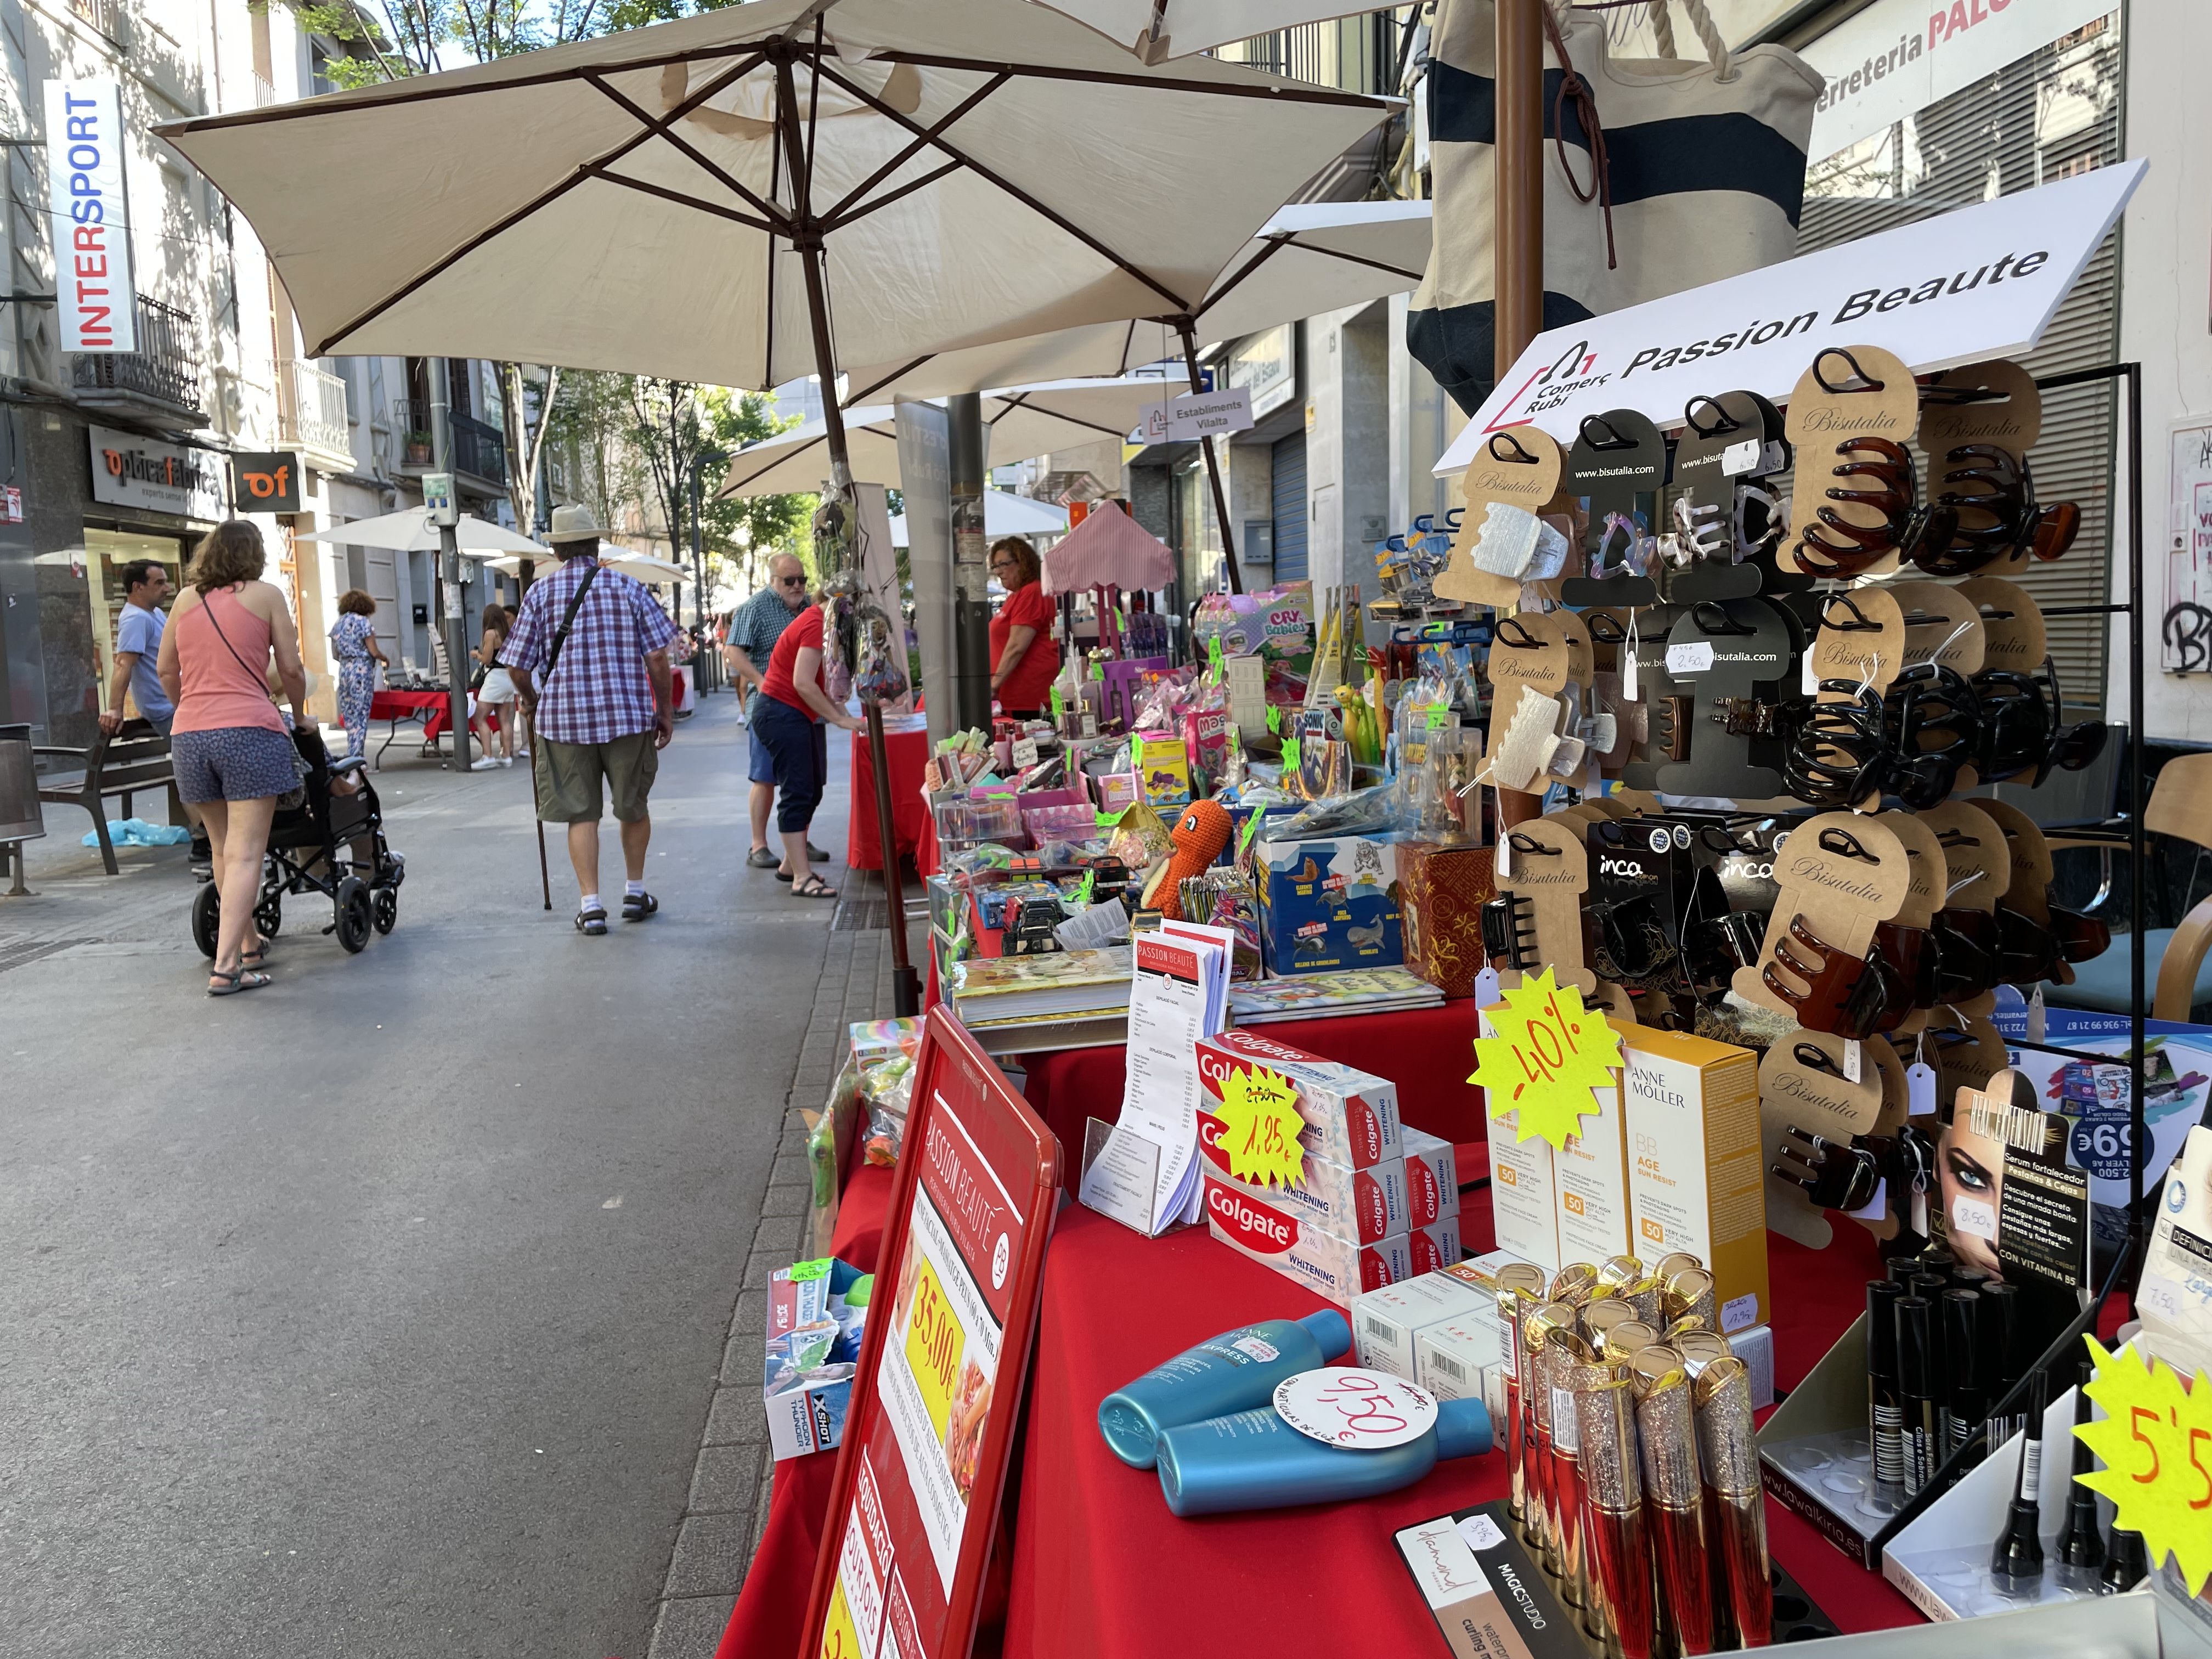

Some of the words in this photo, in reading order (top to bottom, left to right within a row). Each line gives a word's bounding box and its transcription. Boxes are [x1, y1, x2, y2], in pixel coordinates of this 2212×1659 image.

[1816, 33, 1921, 113] erreteria
[65, 91, 113, 347] INTERSPORT
[1622, 311, 1818, 380] Passion
[1830, 249, 2050, 325] Beaute
[1537, 371, 1612, 399] Comerç
[1176, 400, 1242, 419] Establiments
[1525, 392, 1575, 416] Rubí
[1196, 417, 1228, 429] Vilalta
[1803, 407, 1898, 431] Bisutalia
[1933, 415, 2023, 439] Bisutalia
[1575, 464, 1655, 479] www.bisutalia.com
[1681, 451, 1725, 469] www.bisuta
[1475, 471, 1543, 495] Bisutalia
[1265, 622, 1307, 636] Babies
[1269, 609, 1300, 625] CRY
[1714, 652, 1776, 661] isutalia.com
[1824, 640, 1888, 669] Bisutalia
[1903, 645, 1963, 661] sutalia
[1985, 636, 2027, 656] utalia
[1498, 658, 1556, 681] Bisutalia
[1304, 713, 1325, 729] SONIC
[1508, 866, 1577, 884] Bisutalia
[1600, 855, 1643, 877] inca
[1791, 856, 1884, 904] Bisutalia
[1138, 945, 1168, 962] PASSION
[1169, 952, 1195, 968] BEAUTÉ
[2011, 1023, 2027, 1032] 722
[2067, 1022, 2076, 1030] 87
[2080, 1021, 2090, 1030] 21
[2091, 1021, 2102, 1030] 99
[2103, 1020, 2119, 1030] 936
[1223, 1031, 1304, 1062] Colgate
[1511, 991, 1581, 1101] -40%
[1288, 1062, 1336, 1081] WHITENING
[1632, 1066, 1666, 1088] ANNE
[1632, 1080, 1685, 1109] MÖLLER
[1771, 1072, 1859, 1120] Bisutalia
[1365, 1110, 1378, 1159] Colgate
[1379, 1098, 1390, 1146] WHITENING
[1493, 1118, 1505, 1127] SUN
[1573, 1149, 1595, 1162] RESIST
[1635, 1132, 1658, 1156] BB
[1517, 1171, 1530, 1180] VERY
[1530, 1175, 1541, 1184] HIGH
[1637, 1156, 1660, 1173] AGE
[1637, 1168, 1652, 1180] SUN
[1652, 1173, 1678, 1188] RESIST
[2005, 1153, 2030, 1169] Serum
[2032, 1161, 2085, 1186] fortalecedor
[2098, 1168, 2129, 1177] 2.500
[927, 1115, 961, 1194] PASSION
[956, 1168, 1005, 1252] BEAUTÉ
[1424, 1171, 1435, 1218] Colgate
[1437, 1159, 1447, 1205] WHITENING
[2008, 1165, 2044, 1184] Pestañas
[2045, 1178, 2052, 1187] &
[2053, 1181, 2078, 1196] Cejas
[1283, 1185, 1329, 1211] WHITENING
[1372, 1186, 1383, 1235] Colgate
[1386, 1174, 1396, 1221] WHITENING
[1584, 1200, 1598, 1209] VERY
[1599, 1205, 1611, 1214] HIGH
[2003, 1193, 2012, 1201] de
[2013, 1197, 2026, 1206] una
[2027, 1201, 2051, 1215] mirada
[2052, 1209, 2076, 1223] bonita
[2004, 1183, 2035, 1200] Descubre
[2037, 1193, 2043, 1202] el
[2043, 1197, 2070, 1212] secreto
[1209, 1187, 1288, 1245] Colgate
[2002, 1204, 2033, 1222] Consigue
[2034, 1217, 2051, 1227] unas
[2002, 1214, 2032, 1231] pestañas
[2033, 1224, 2047, 1234] más
[2048, 1229, 2073, 1244] largas,
[1664, 1227, 1679, 1237] VERY
[1679, 1233, 1694, 1243] HIGH
[2001, 1221, 2028, 1236] espesas
[2028, 1231, 2033, 1239] y
[960, 1233, 975, 1263] VILALTA
[1427, 1243, 1440, 1272] gate
[1289, 1253, 1335, 1285] WHITENING
[1296, 1266, 1312, 1279] naturally
[1313, 1275, 1325, 1285] whiter
[1325, 1281, 1335, 1291] teeth
[1378, 1261, 1388, 1289] gate
[1999, 1249, 2018, 1263] CON
[2021, 1256, 2062, 1282] VITAMINA
[2064, 1276, 2076, 1286] B5
[914, 1275, 956, 1401] 35,00€
[982, 1324, 998, 1367] Min.)
[1200, 1344, 1250, 1365] EXPRESS
[791, 1400, 804, 1448] THUNDER
[797, 1397, 811, 1446] TYPHOON
[1286, 1378, 1299, 1389] CON
[1299, 1423, 1310, 1431] DE
[1313, 1429, 1336, 1443] LUZ
[902, 1362, 925, 1427] PRODUCTES
[921, 1413, 938, 1463] D'ALTA
[933, 1444, 962, 1526] COSMÈTICA
[917, 1449, 929, 1486] ALTA
[925, 1471, 954, 1553] COSMÉTICA
[857, 1467, 889, 1578] LIQUIDACIÓ
[1418, 1530, 1478, 1594] diamond
[1497, 1562, 1548, 1630] MAGICSTUDIO
[893, 1583, 912, 1651] PASSION
[1462, 1618, 1485, 1652] curling
